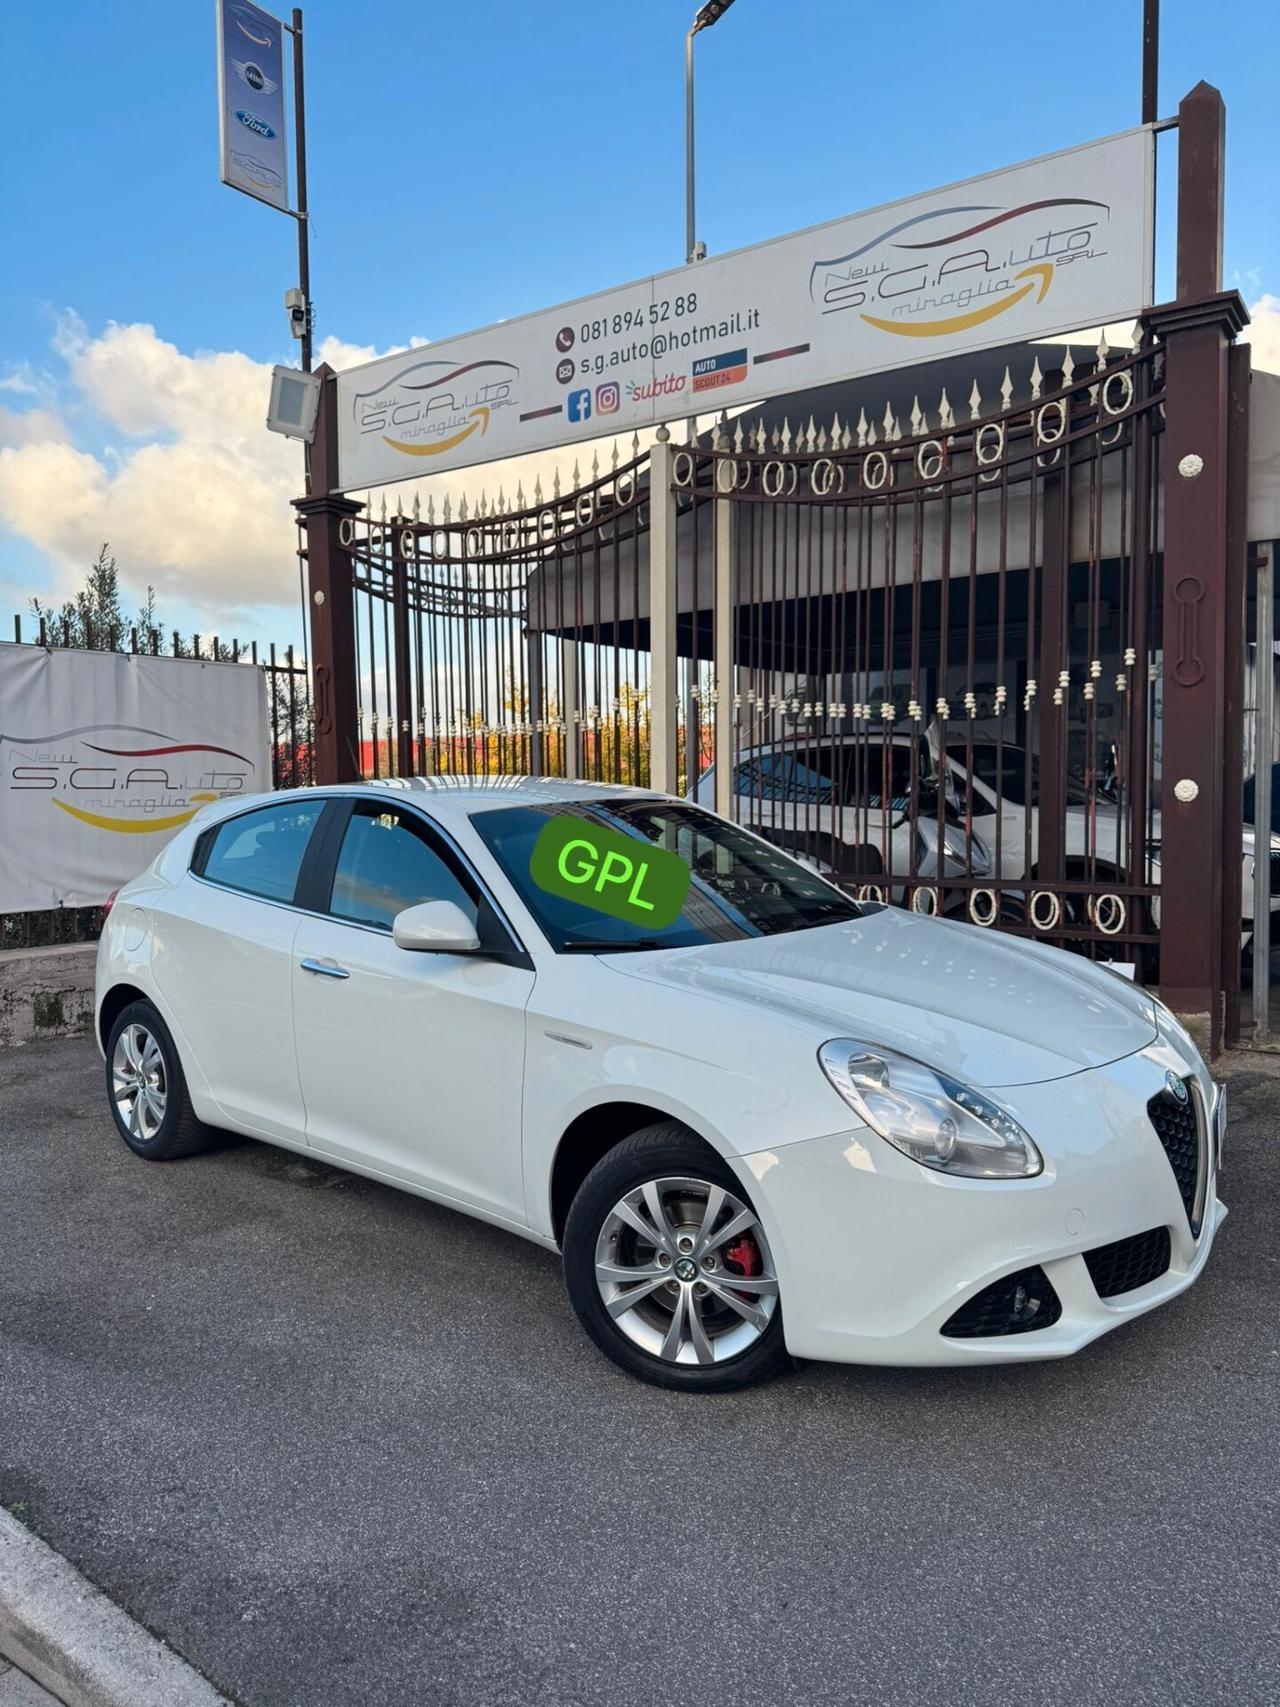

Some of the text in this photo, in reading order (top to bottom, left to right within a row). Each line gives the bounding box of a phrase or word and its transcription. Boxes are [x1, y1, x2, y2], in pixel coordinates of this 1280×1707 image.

[246, 71, 264, 86] MINI
[242, 112, 270, 136] Ford
[580, 292, 698, 344] 081 894 52 88
[580, 308, 760, 375] s.g.auto@hotmail.it
[694, 359, 716, 374] AUTO
[632, 372, 687, 402] subito
